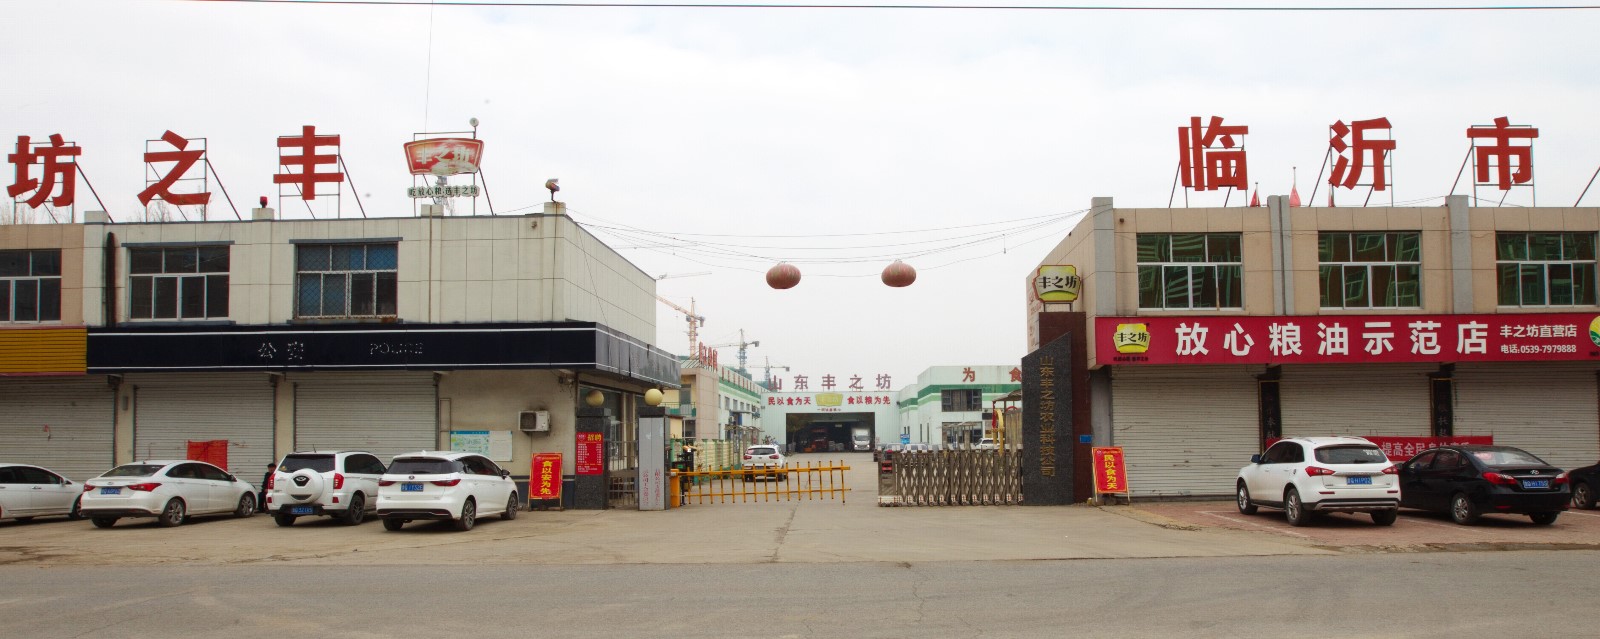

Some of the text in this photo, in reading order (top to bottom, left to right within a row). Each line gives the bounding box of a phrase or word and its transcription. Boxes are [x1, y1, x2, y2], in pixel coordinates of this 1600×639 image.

[1038, 275, 1078, 289] 丰之坊
[1116, 332, 1149, 343] 丰之坊
[1499, 324, 1578, 338] 丰之坊直营店
[1174, 320, 1489, 357] 放心粮油示范店
[767, 374, 892, 391] 山东丰之坊
[767, 396, 812, 406] 民以食为天
[847, 395, 892, 405] 食以粮为先
[1040, 355, 1056, 477] 山东丰之坊农业科技公司
[1103, 454, 1118, 490] 民以食为天
